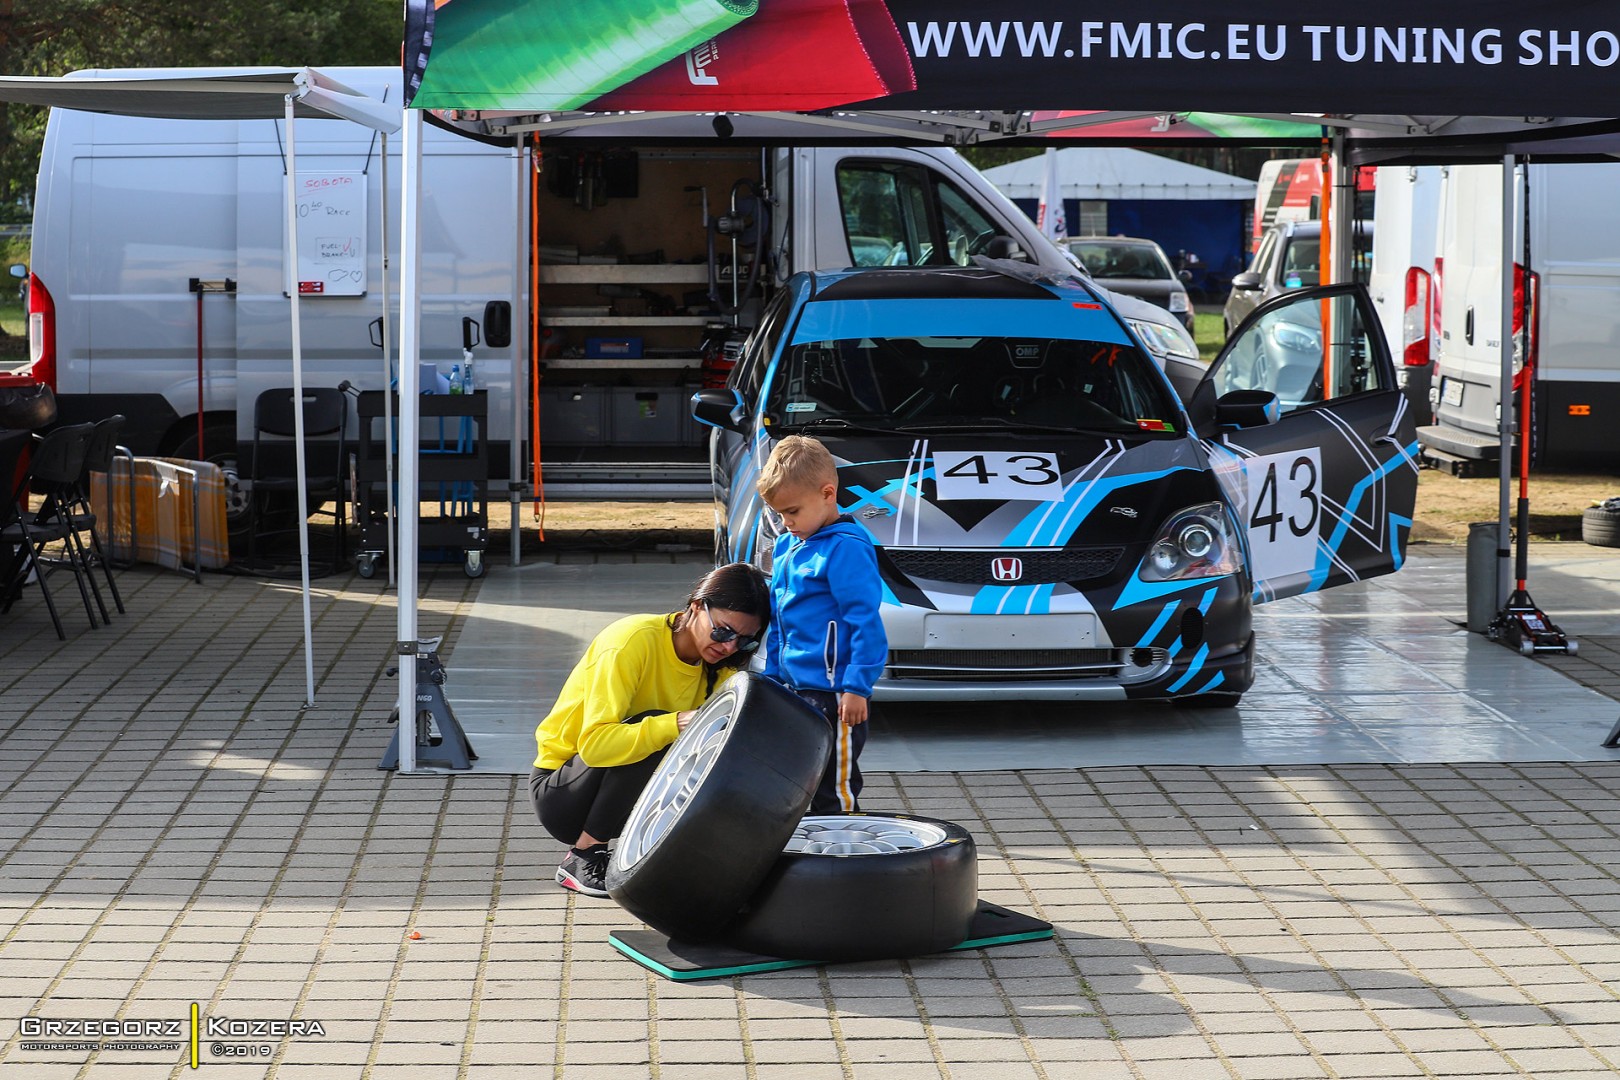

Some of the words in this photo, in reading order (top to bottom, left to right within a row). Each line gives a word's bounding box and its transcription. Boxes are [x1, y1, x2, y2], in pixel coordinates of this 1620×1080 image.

[906, 20, 1287, 61] WWW.FMIC.EU
[1302, 25, 1503, 64] TUNING
[1518, 29, 1620, 67] SHO
[304, 177, 353, 188] SOBOTA
[943, 455, 1060, 486] 43
[1250, 456, 1319, 543] 43
